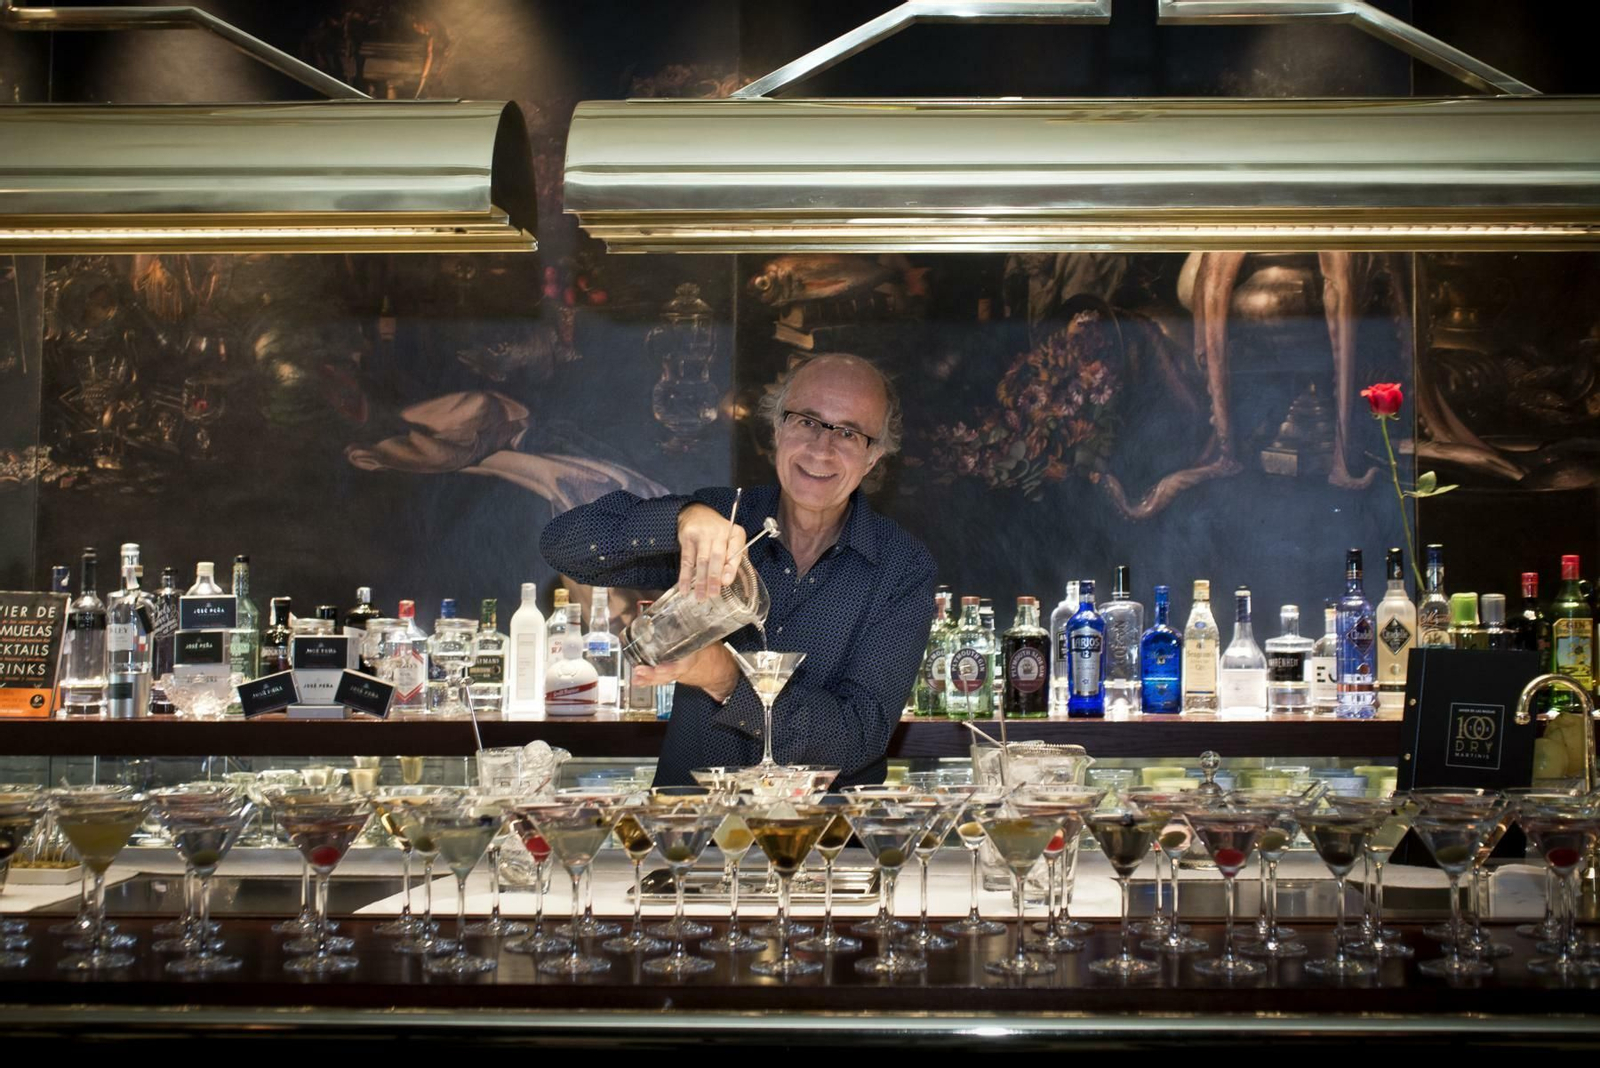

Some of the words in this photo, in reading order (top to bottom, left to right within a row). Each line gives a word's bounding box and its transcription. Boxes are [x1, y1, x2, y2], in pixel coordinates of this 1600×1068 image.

[36, 606, 56, 618] DE
[951, 650, 979, 672] PLYMOUTH
[1456, 715, 1495, 741] 100
[1456, 740, 1494, 753] DRY
